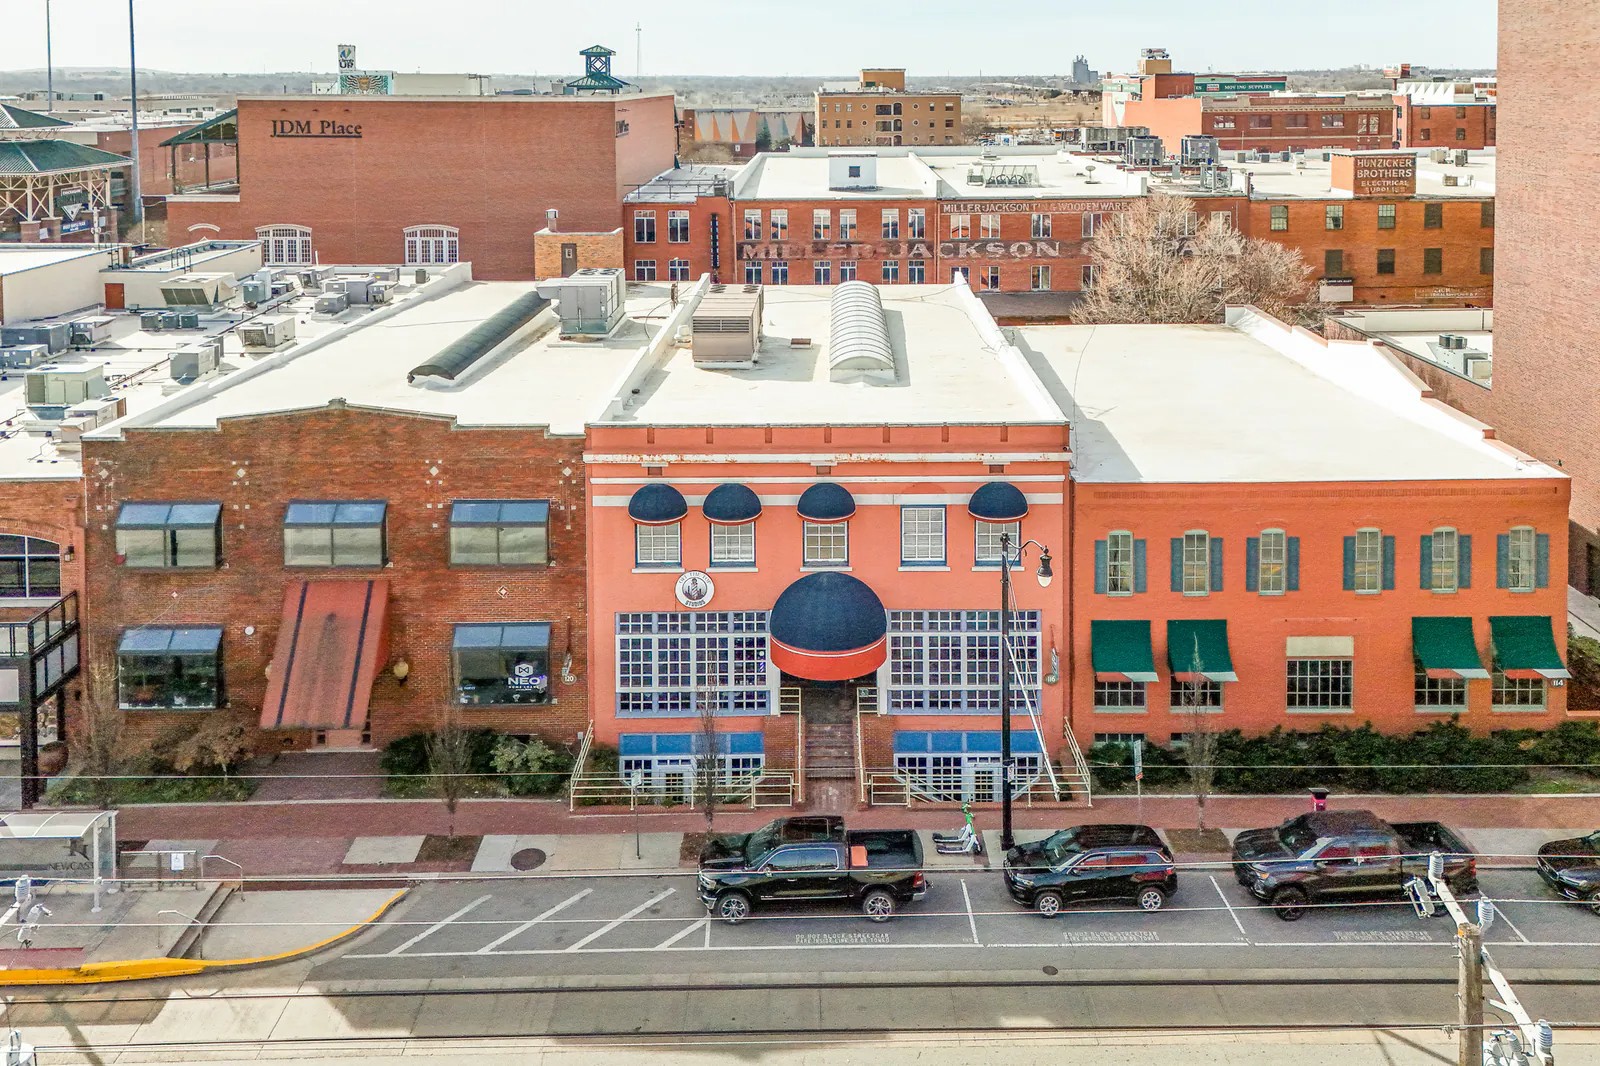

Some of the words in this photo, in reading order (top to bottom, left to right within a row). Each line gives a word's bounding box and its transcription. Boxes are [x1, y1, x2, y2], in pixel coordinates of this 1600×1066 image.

[270, 119, 312, 138] JDM
[319, 119, 362, 135] Place
[1357, 158, 1412, 168] HUNZICKER
[1357, 168, 1412, 178] BROTHERS
[1361, 179, 1410, 187] ELECTRICAL
[508, 677, 540, 685] NEO
